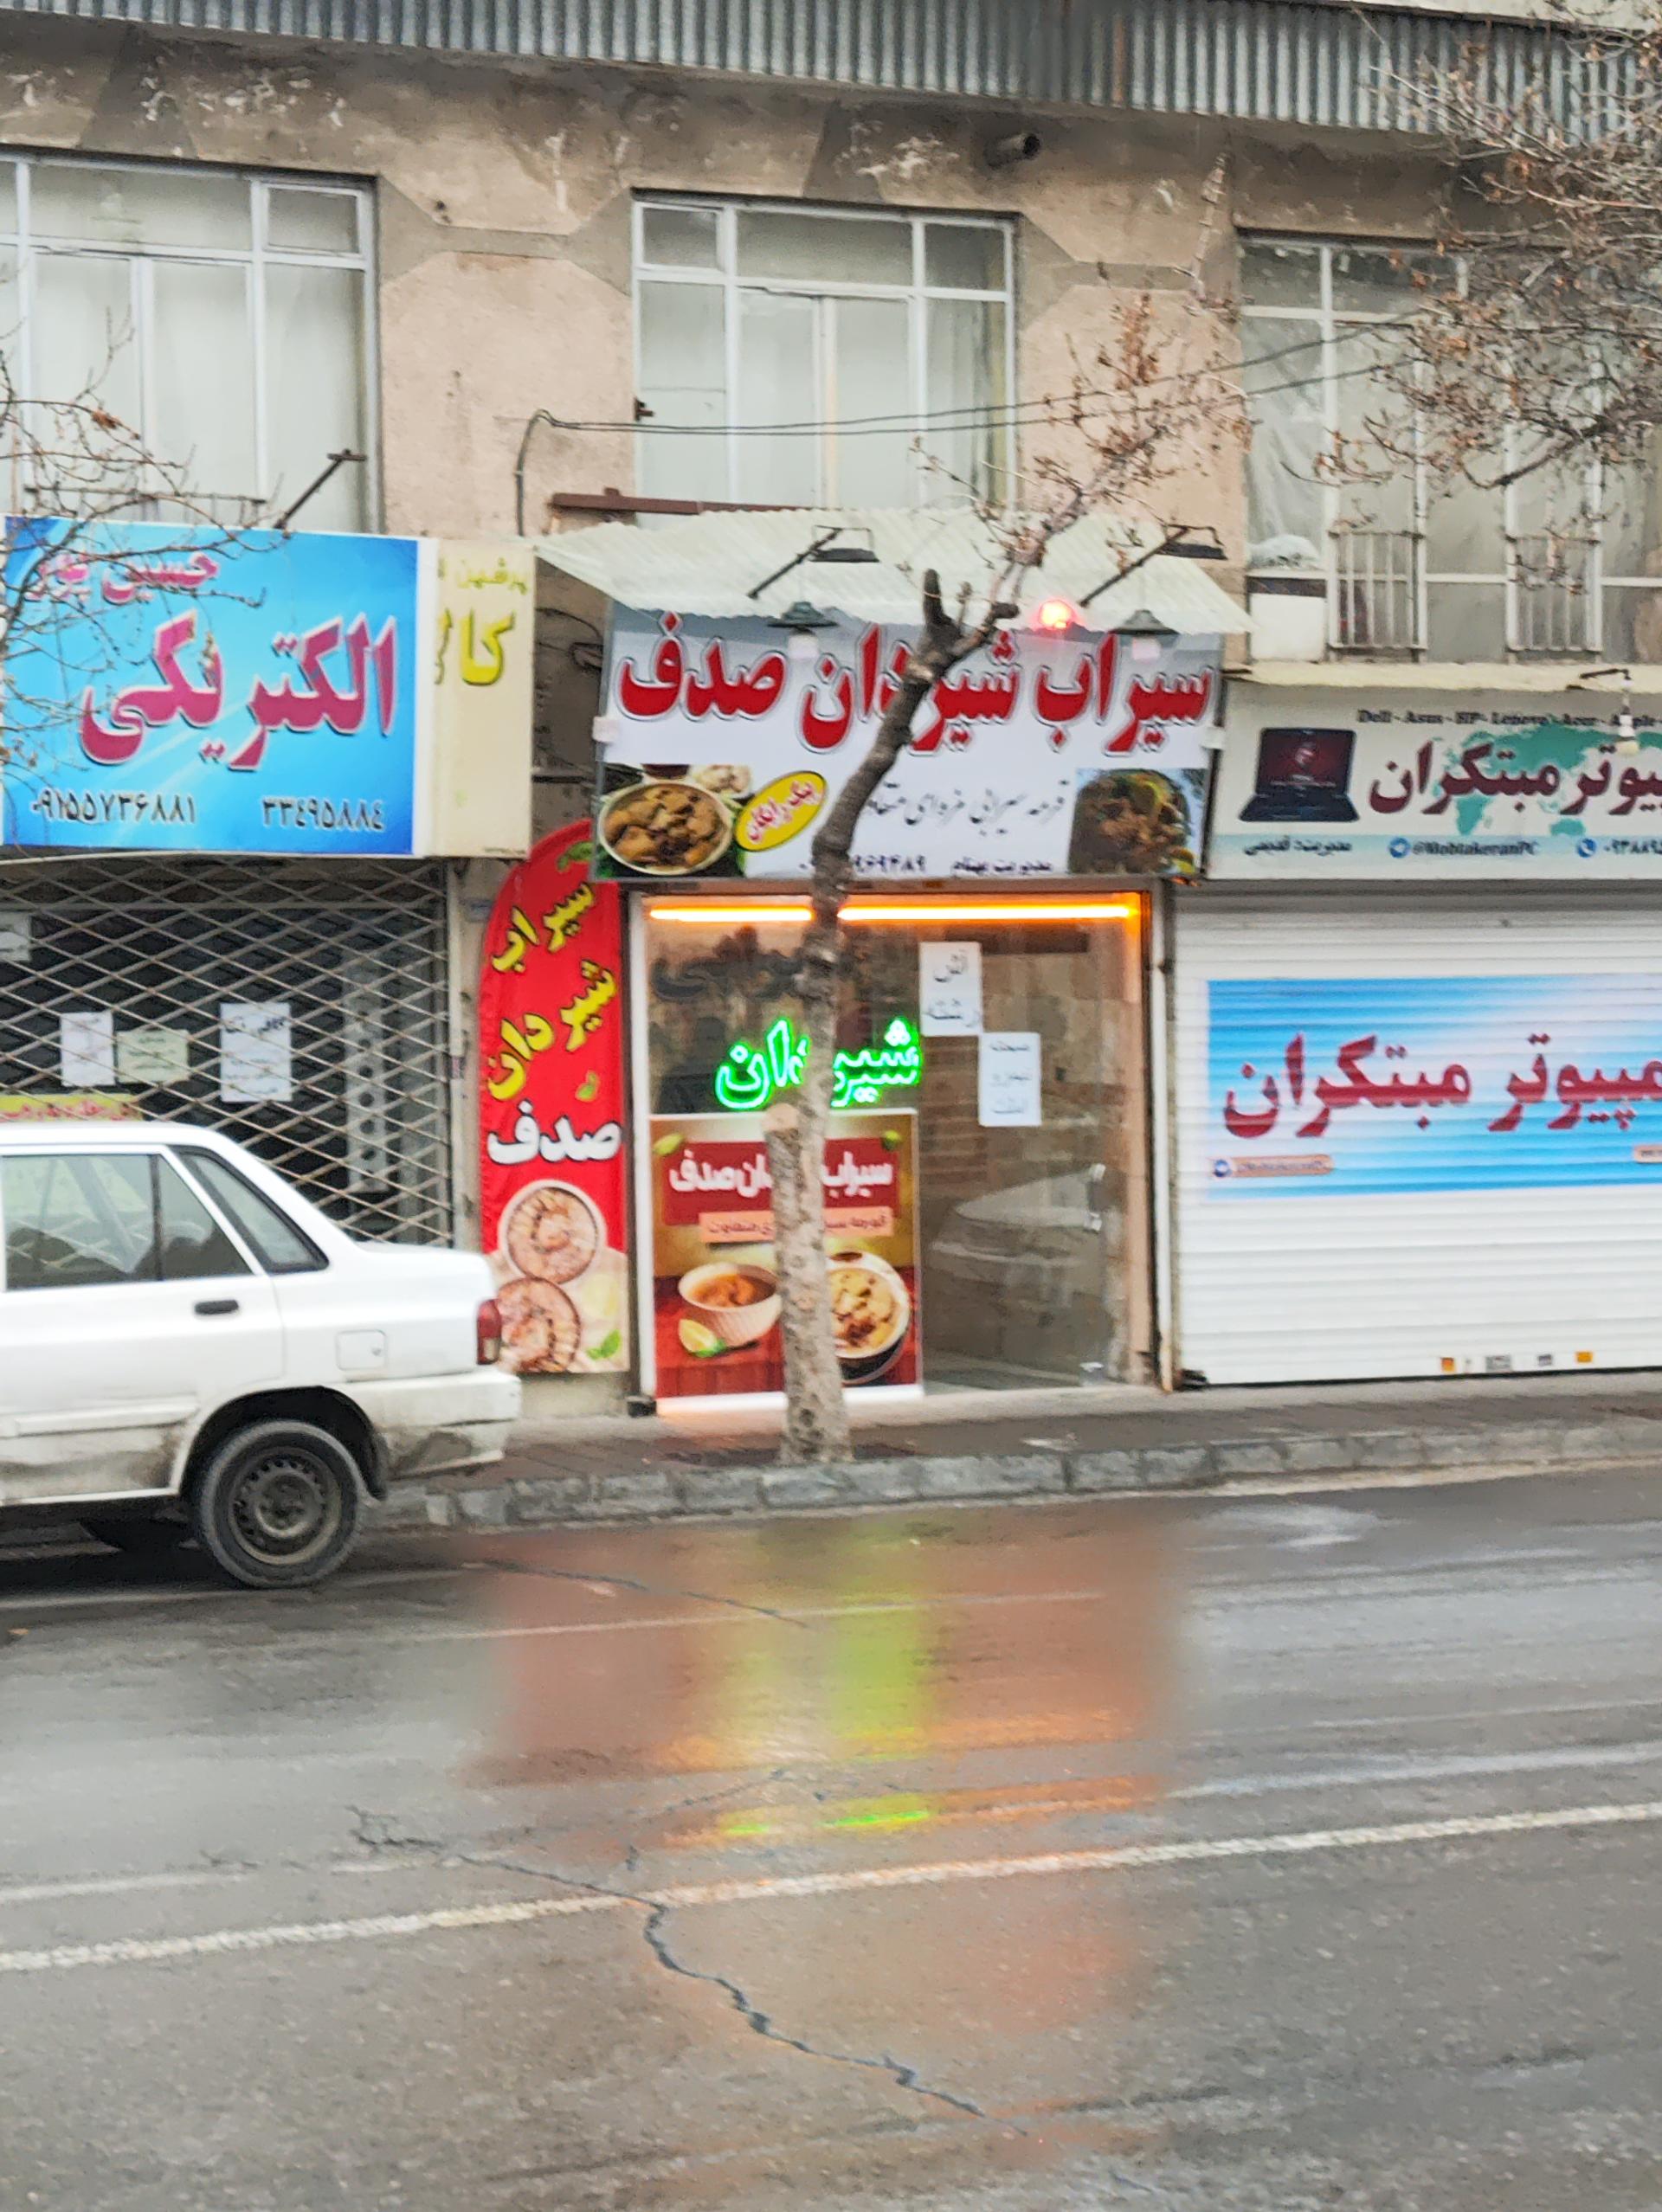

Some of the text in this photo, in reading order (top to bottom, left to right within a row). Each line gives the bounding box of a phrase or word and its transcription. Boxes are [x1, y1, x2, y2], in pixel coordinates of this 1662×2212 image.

[79, 609, 398, 771] الکتریکی
[616, 609, 789, 723] صدف
[1034, 630, 1214, 756] سیراب
[1368, 741, 1560, 815] مبتکران
[491, 881, 596, 974] سیراب
[486, 1098, 622, 1166] صدف
[1222, 1032, 1473, 1139] مبتکران
